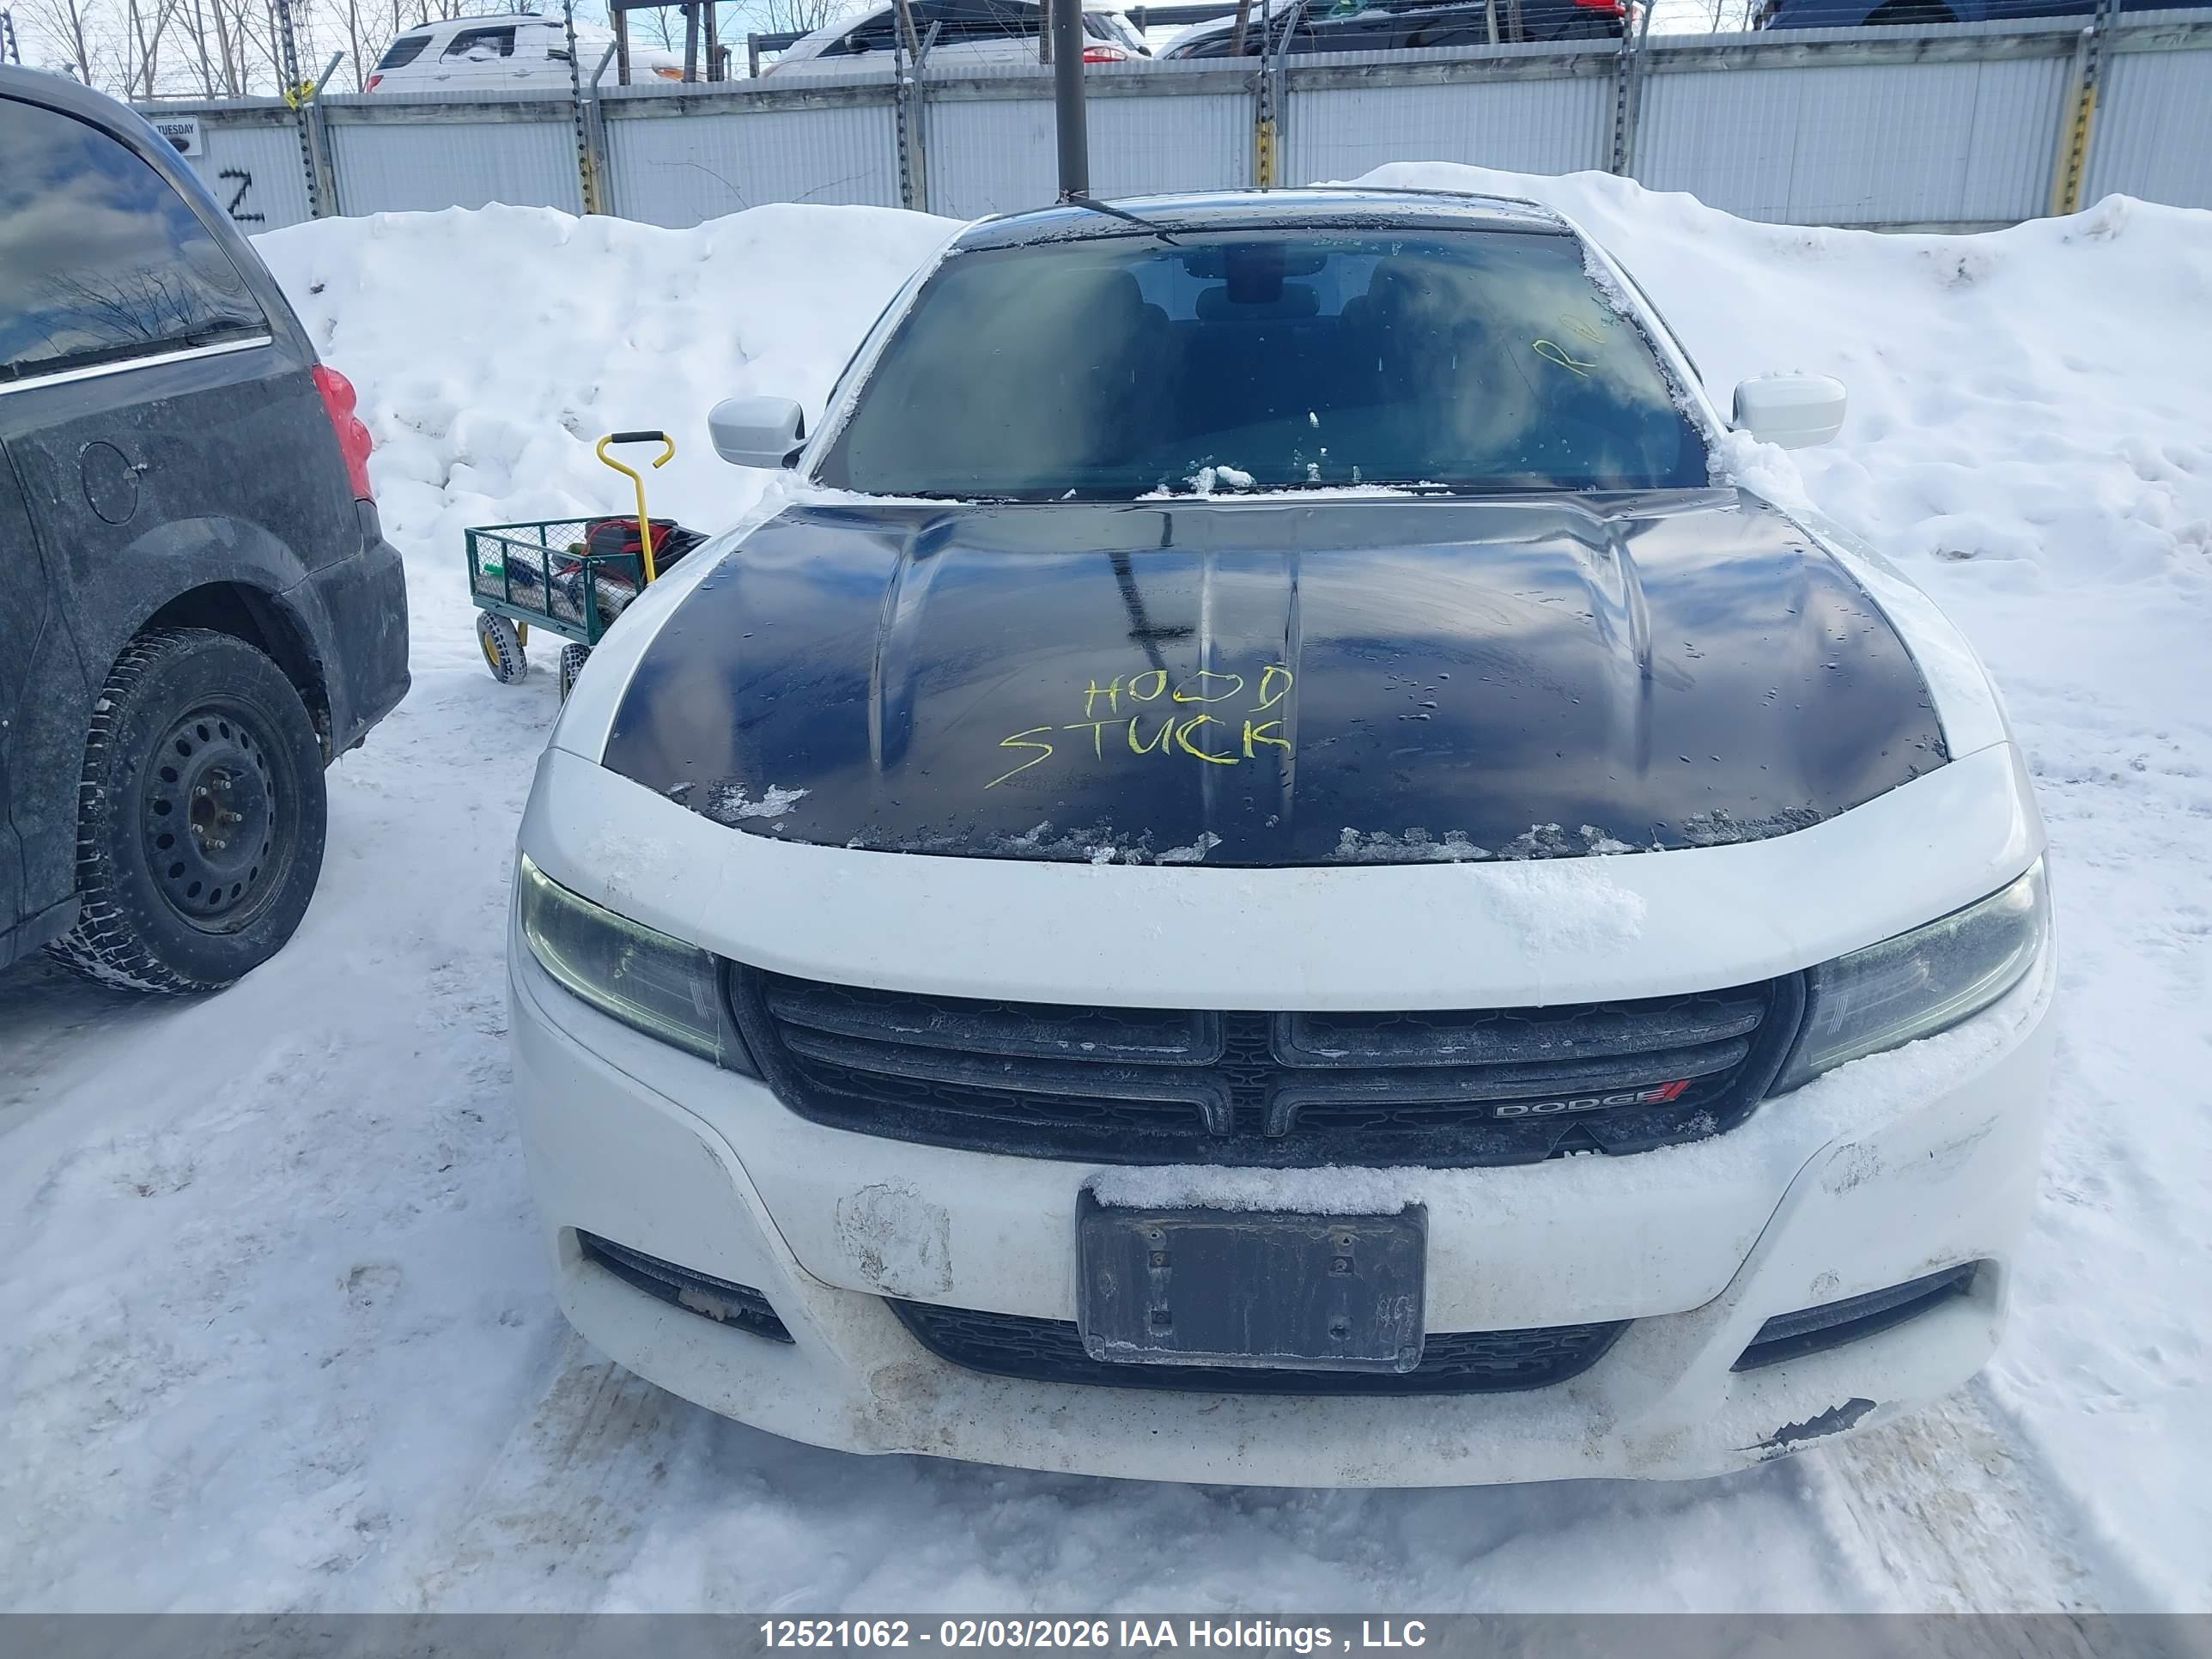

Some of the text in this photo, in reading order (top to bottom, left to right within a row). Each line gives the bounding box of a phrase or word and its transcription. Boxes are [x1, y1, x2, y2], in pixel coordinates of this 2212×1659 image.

[156, 124, 193, 135] TUESDAY
[1084, 665, 1293, 718] HOOD
[984, 714, 1291, 791] STUCK
[1495, 1088, 1666, 1117] DODGE
